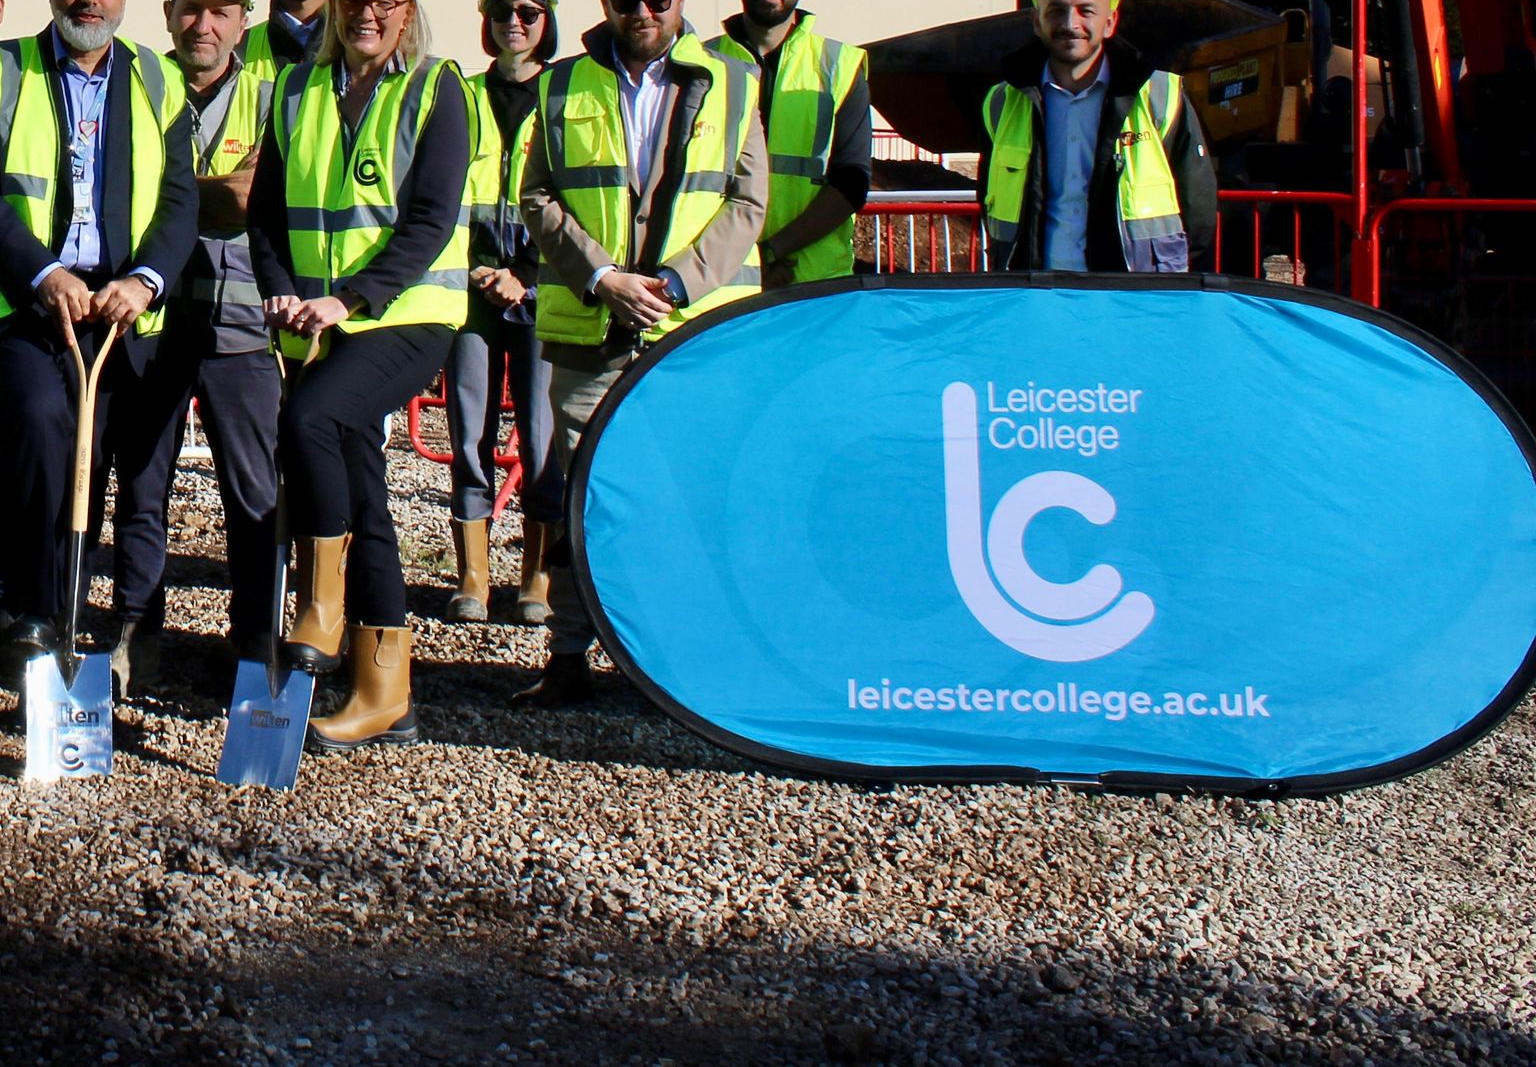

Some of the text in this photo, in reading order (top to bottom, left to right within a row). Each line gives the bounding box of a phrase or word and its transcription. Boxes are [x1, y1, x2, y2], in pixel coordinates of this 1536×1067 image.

[1224, 82, 1243, 99] HIRE
[987, 381, 1143, 414] Leicester
[988, 417, 1121, 457] College
[847, 678, 1271, 721] leicestercollege.ac.uk
